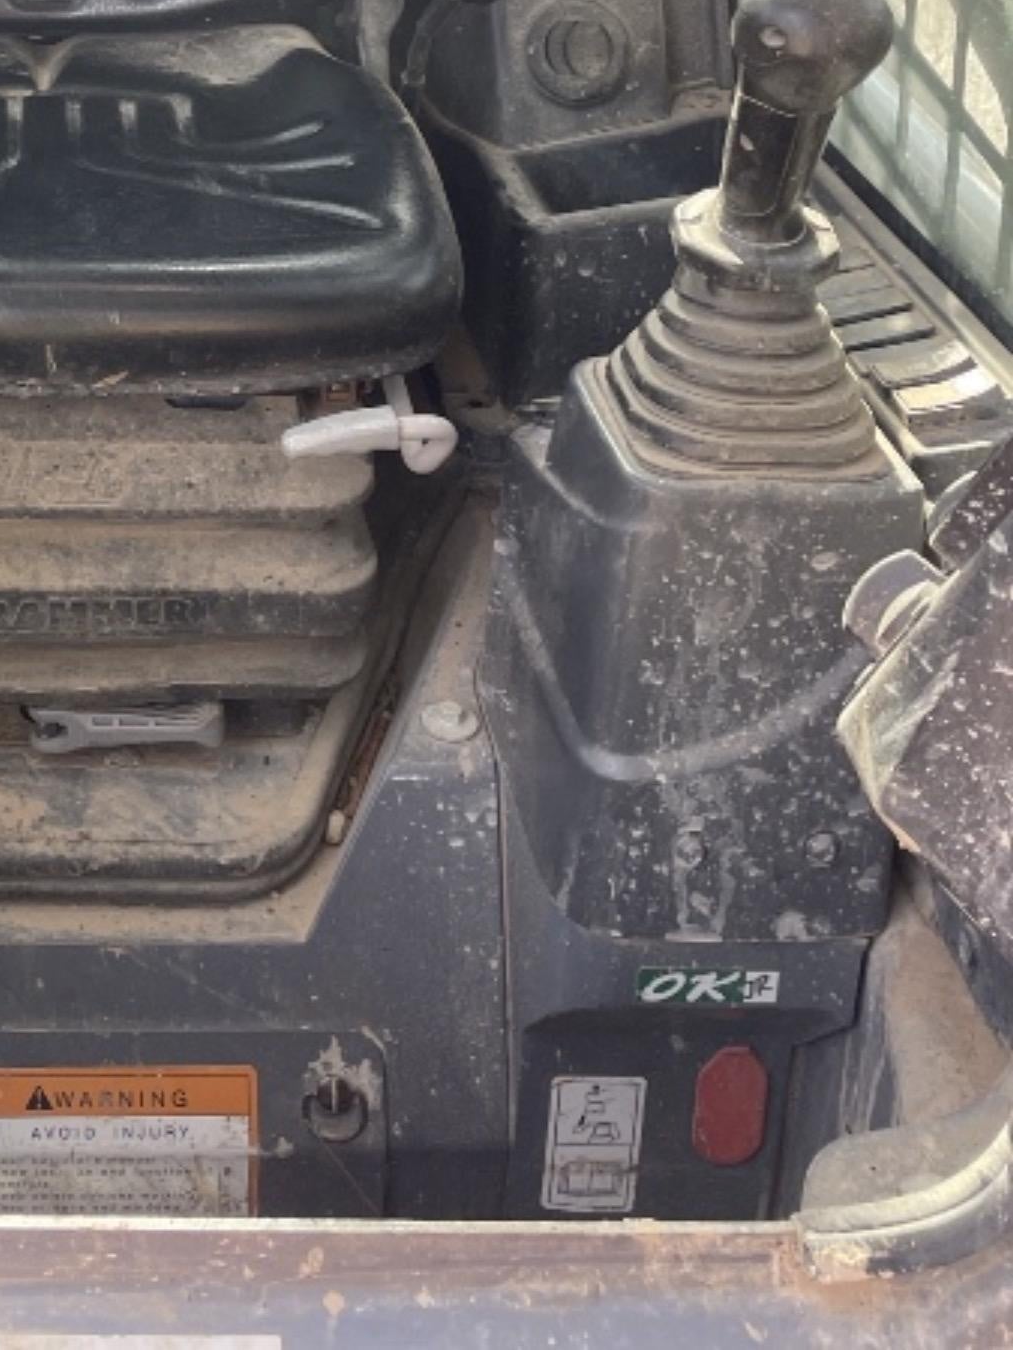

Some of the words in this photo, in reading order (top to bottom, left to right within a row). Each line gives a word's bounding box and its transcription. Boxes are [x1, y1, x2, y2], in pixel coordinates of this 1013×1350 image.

[641, 971, 741, 1002] OK
[55, 1088, 189, 1108] WARNING
[30, 1126, 96, 1141] AVOID
[112, 1126, 190, 1141] INJURY
